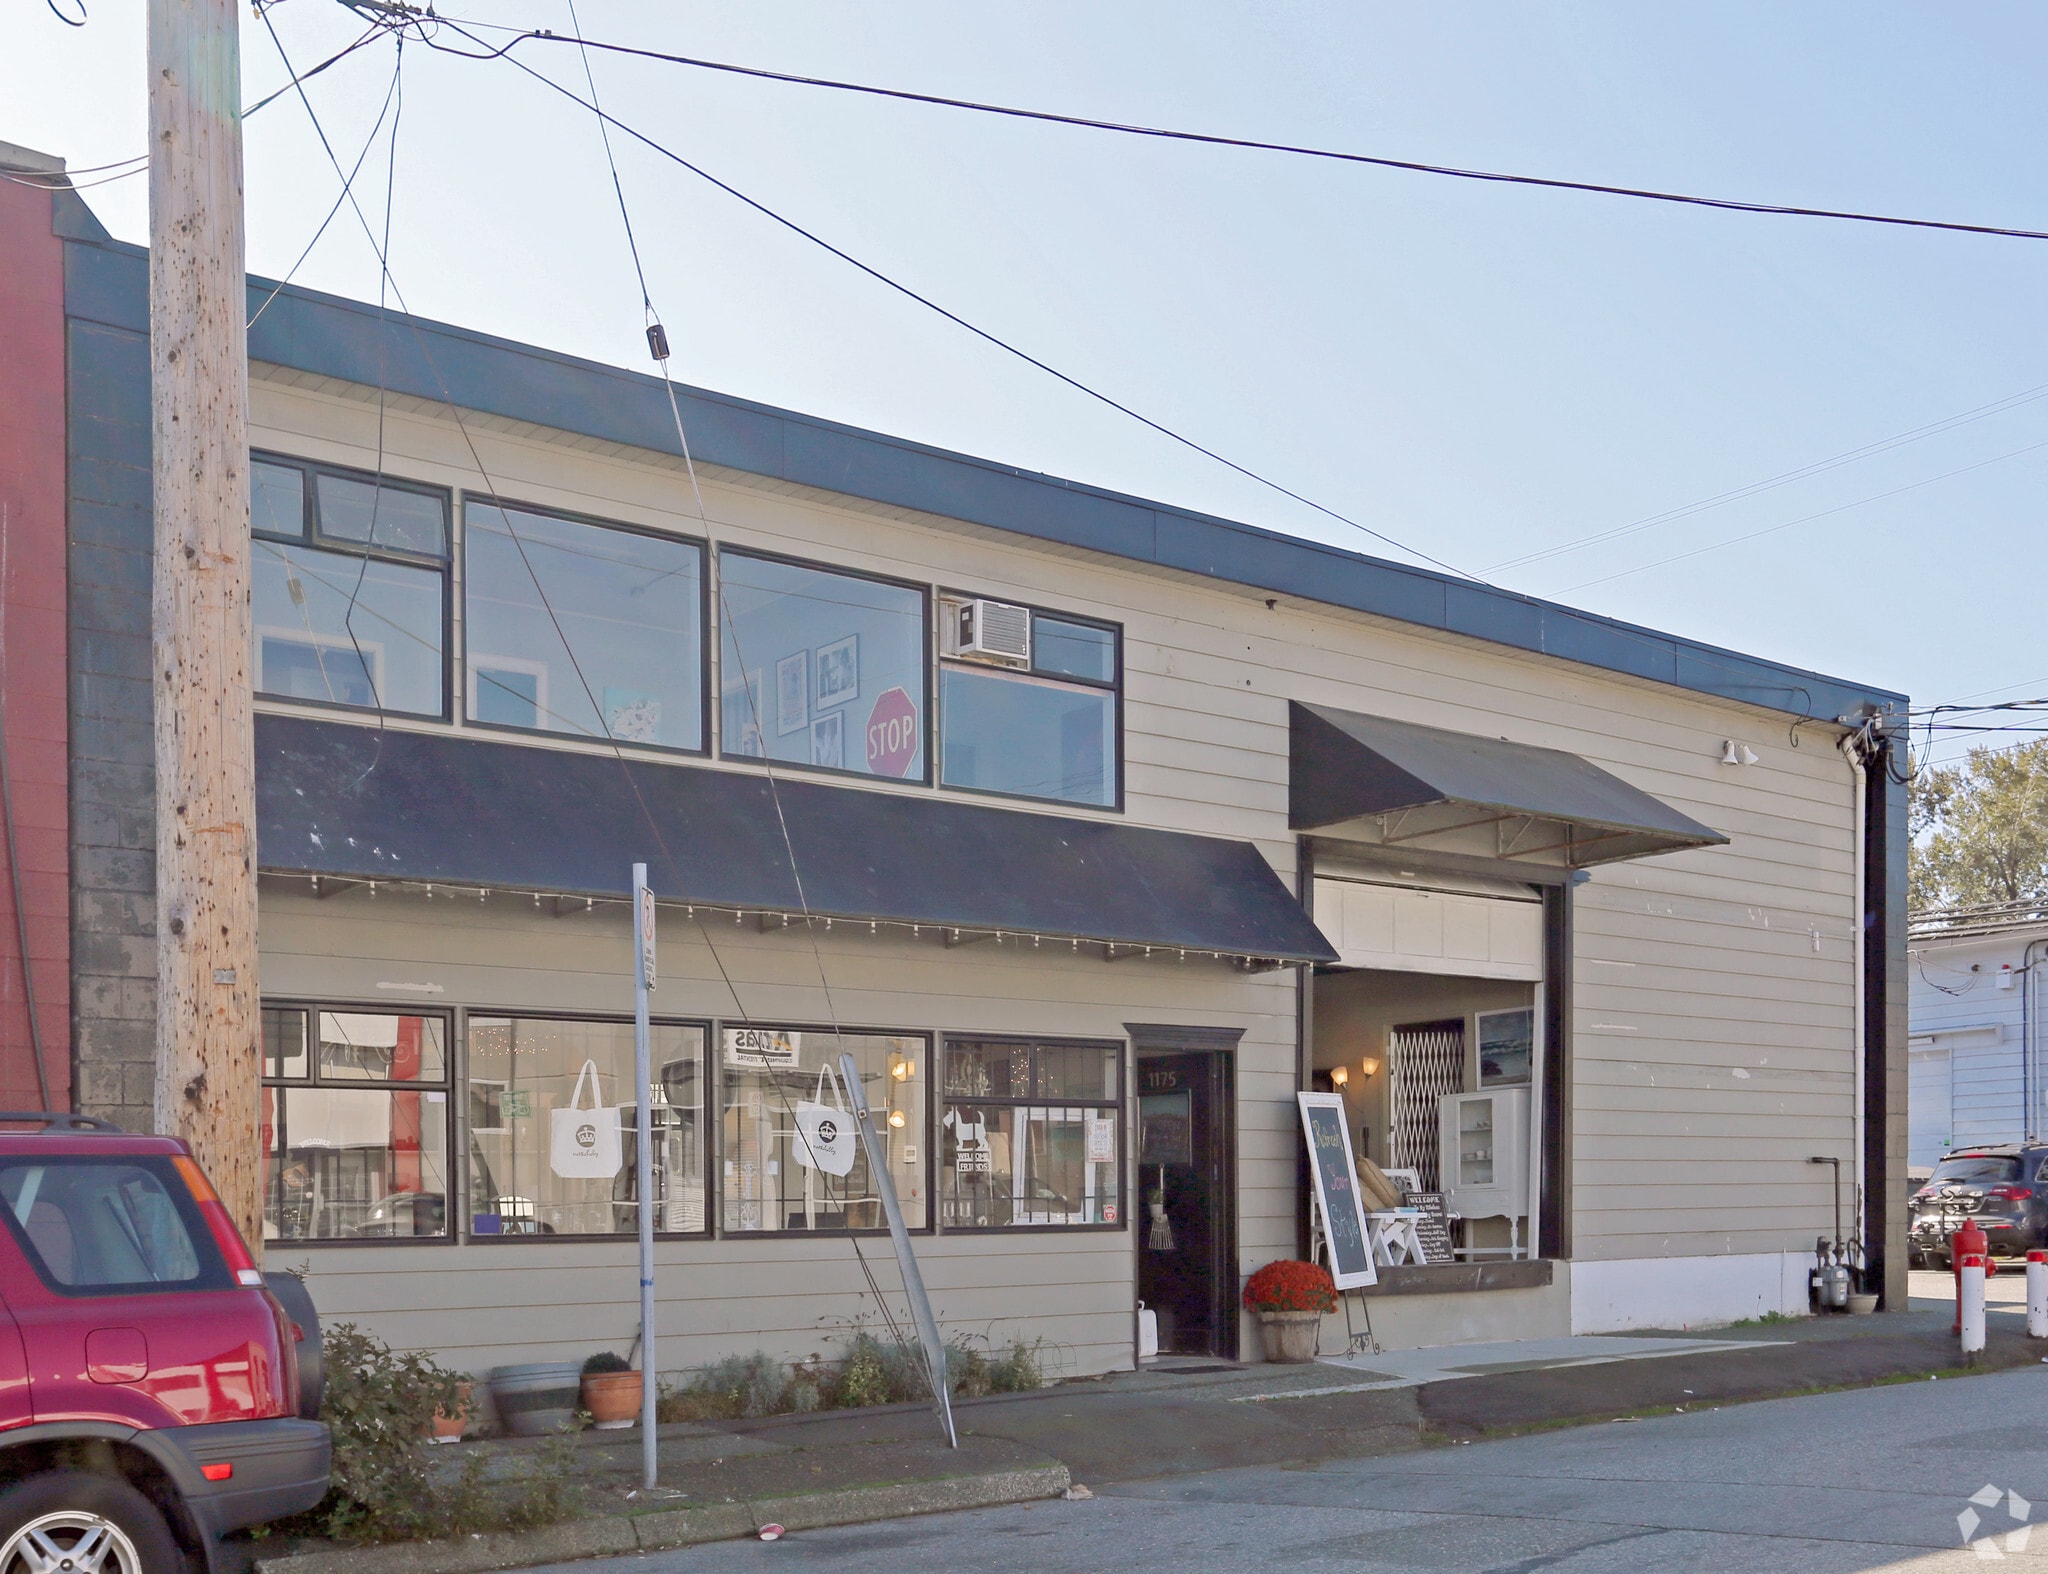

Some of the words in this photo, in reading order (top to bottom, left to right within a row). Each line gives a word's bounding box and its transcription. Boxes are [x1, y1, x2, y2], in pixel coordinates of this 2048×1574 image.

[869, 715, 914, 760] STOP
[1148, 1071, 1177, 1088] 1175
[1330, 1203, 1360, 1248] Style
